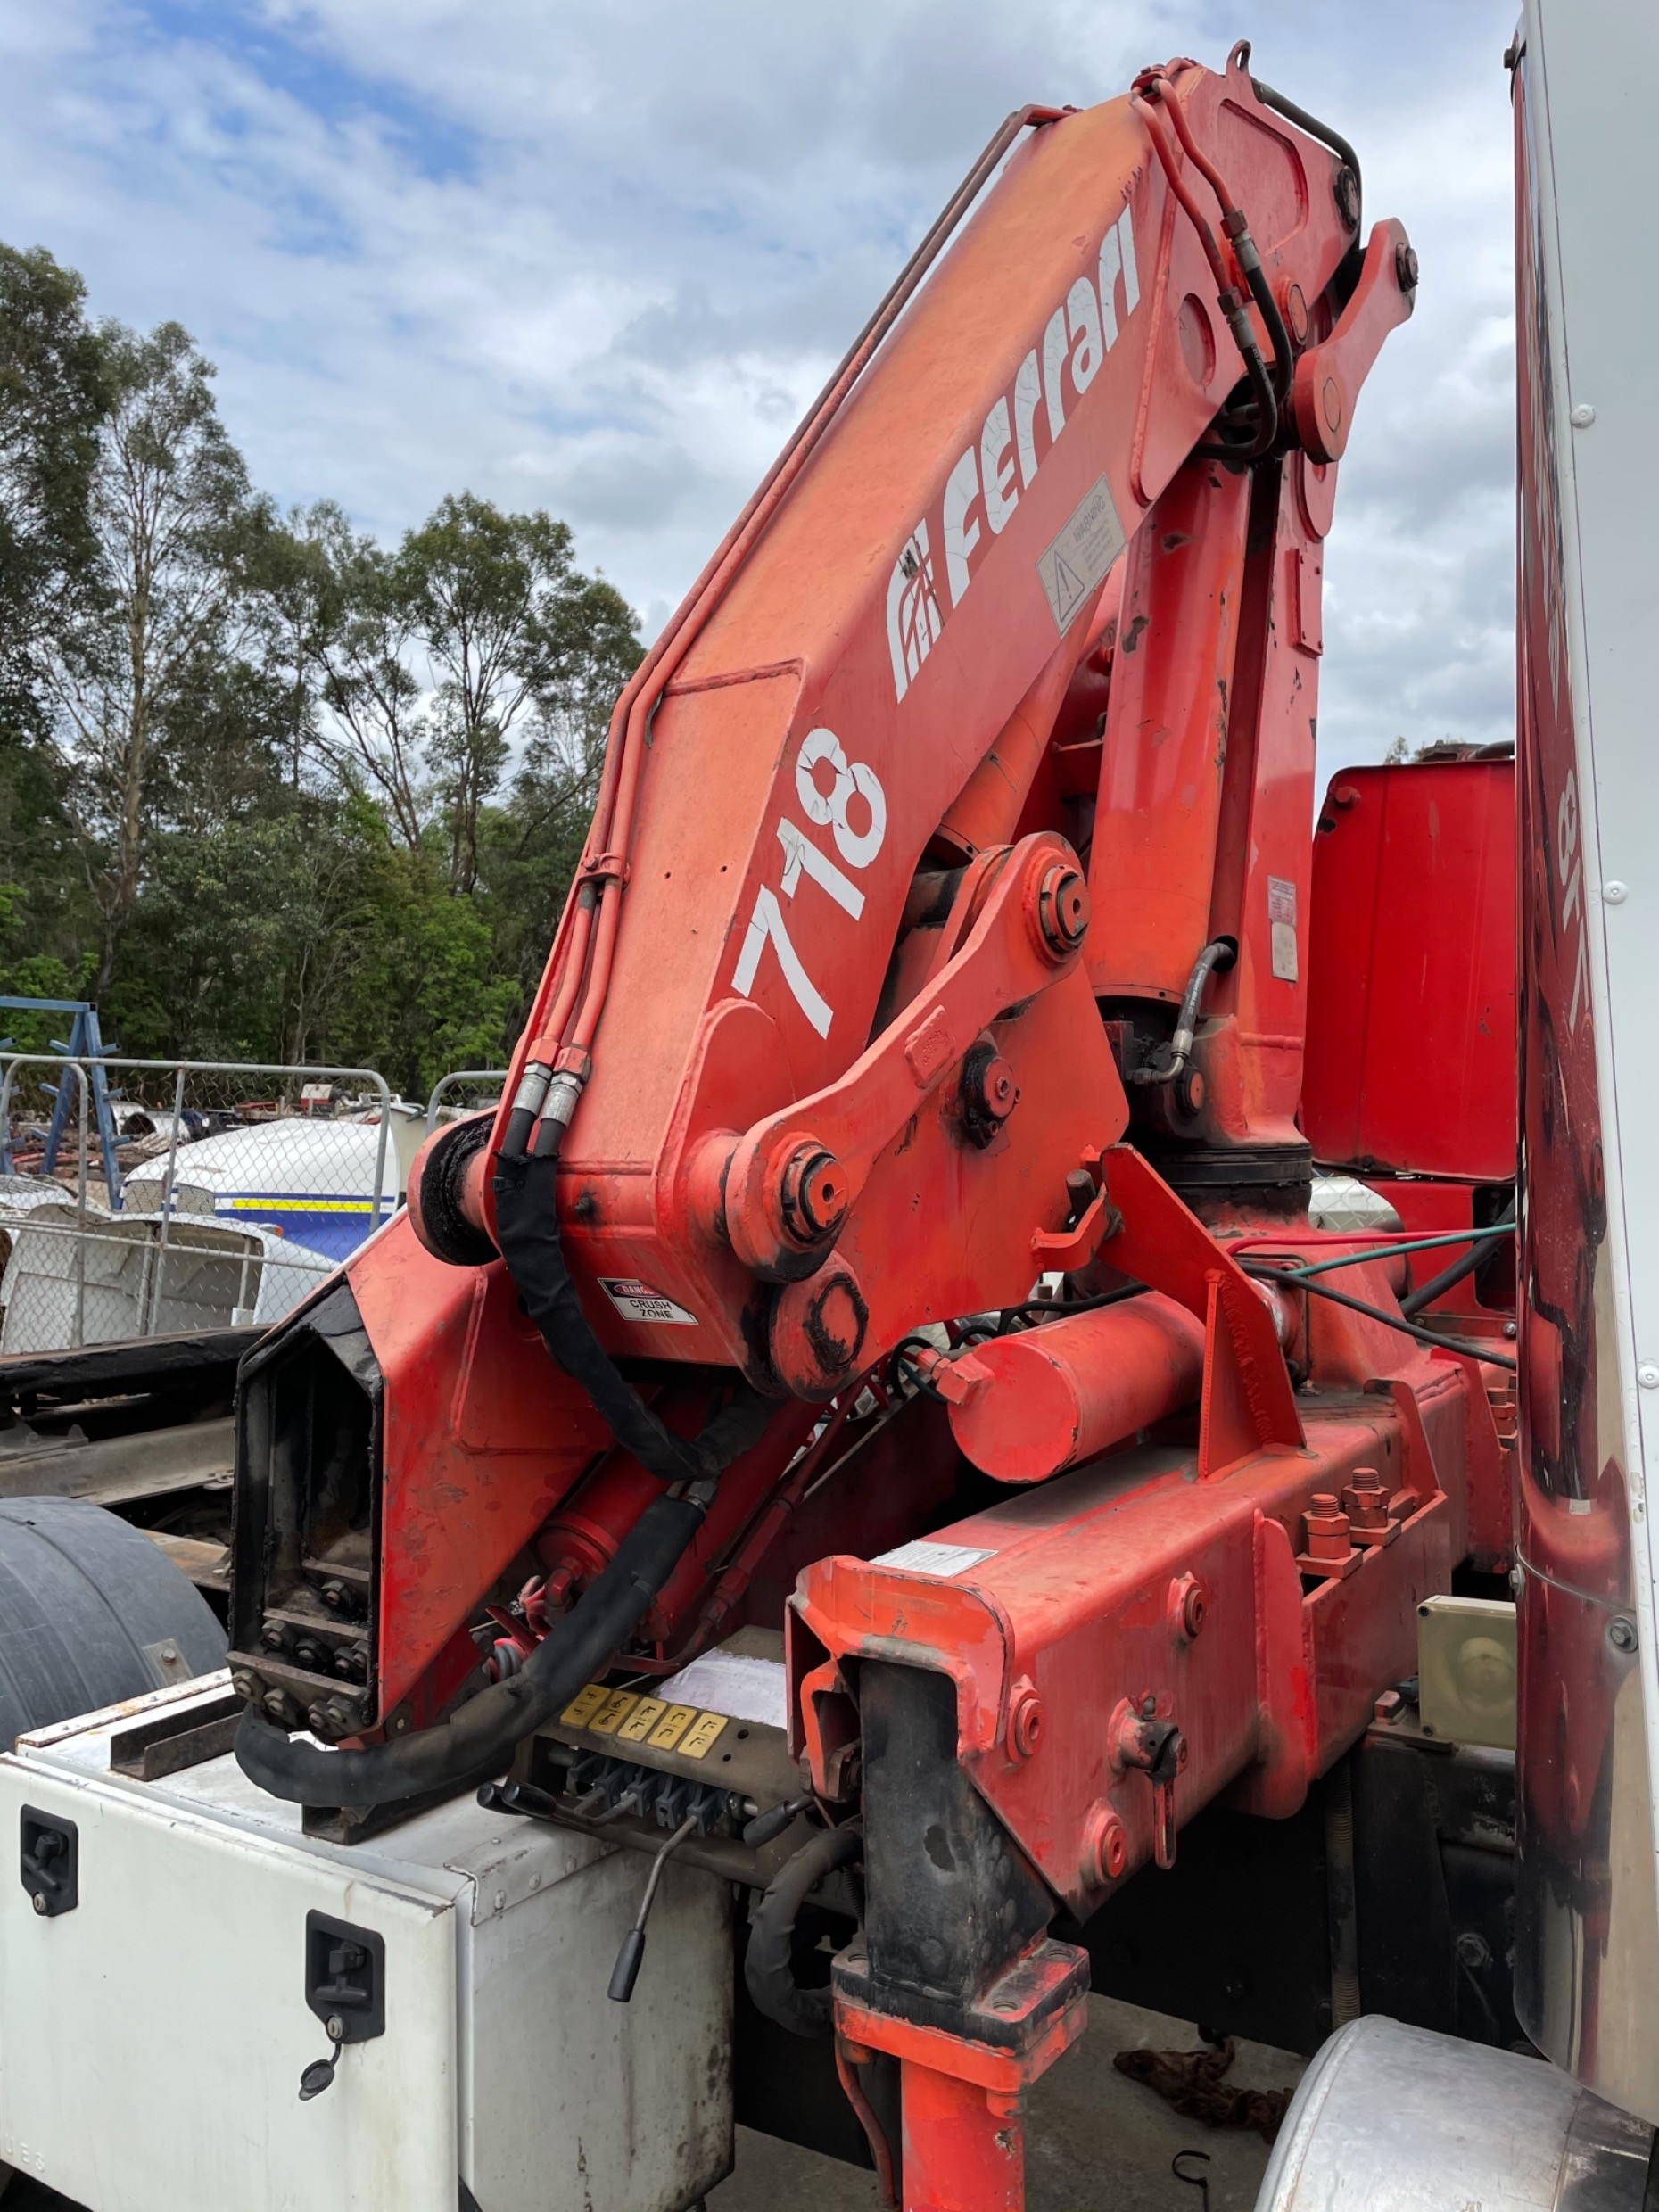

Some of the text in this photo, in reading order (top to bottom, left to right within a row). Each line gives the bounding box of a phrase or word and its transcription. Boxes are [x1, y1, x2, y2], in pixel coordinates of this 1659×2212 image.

[1073, 495, 1106, 542] WARNING
[732, 728, 887, 1040] 718
[630, 1300, 672, 1309] CRUSH
[640, 1309, 673, 1318] ZONE
